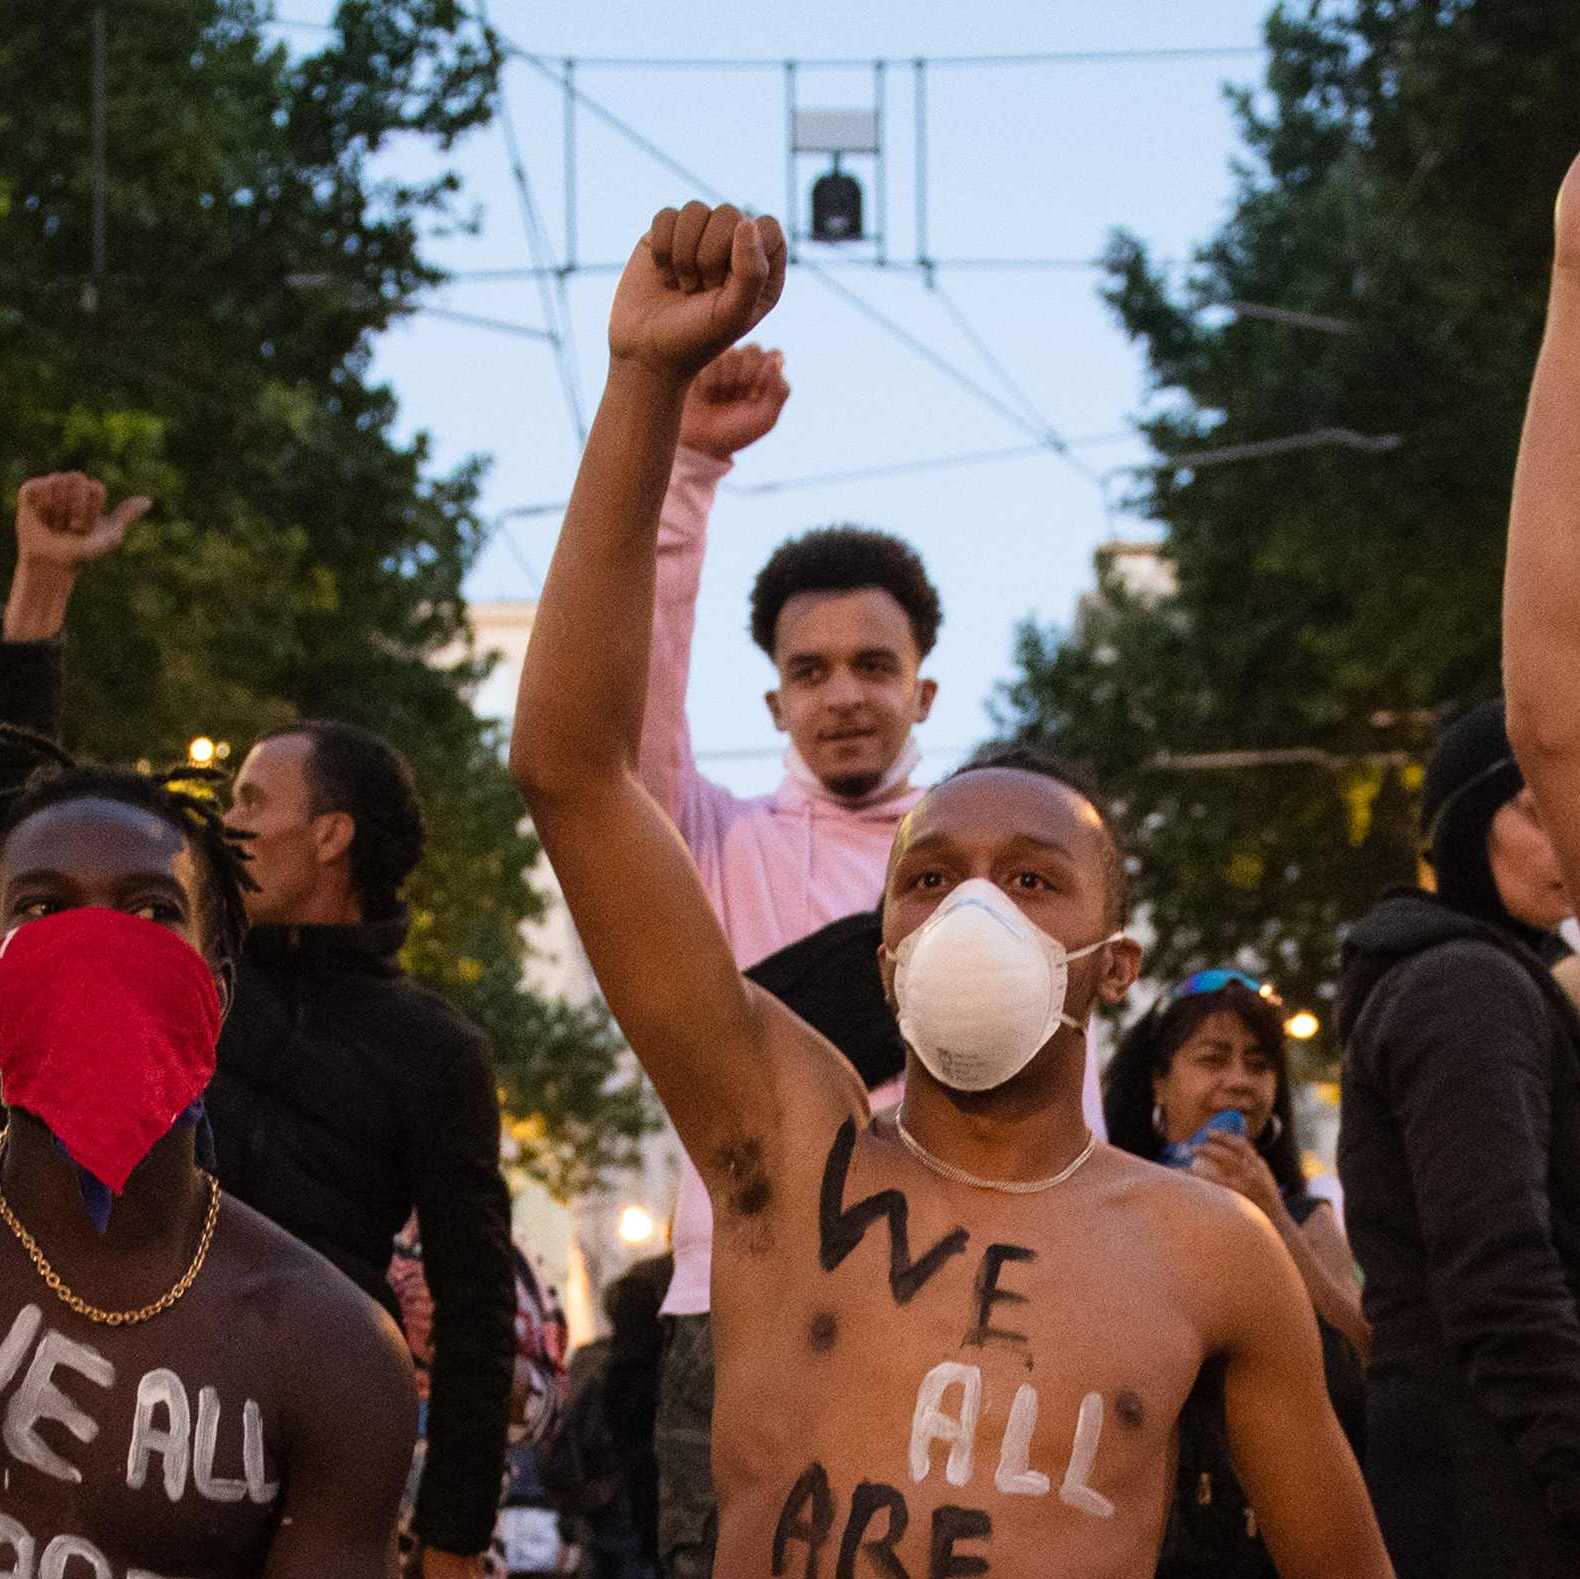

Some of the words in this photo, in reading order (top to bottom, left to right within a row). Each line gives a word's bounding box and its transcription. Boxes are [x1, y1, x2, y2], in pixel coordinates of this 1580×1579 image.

[820, 1114, 1036, 1349] WE
[127, 1367, 279, 1505] ALL
[908, 1360, 1116, 1519] ALL
